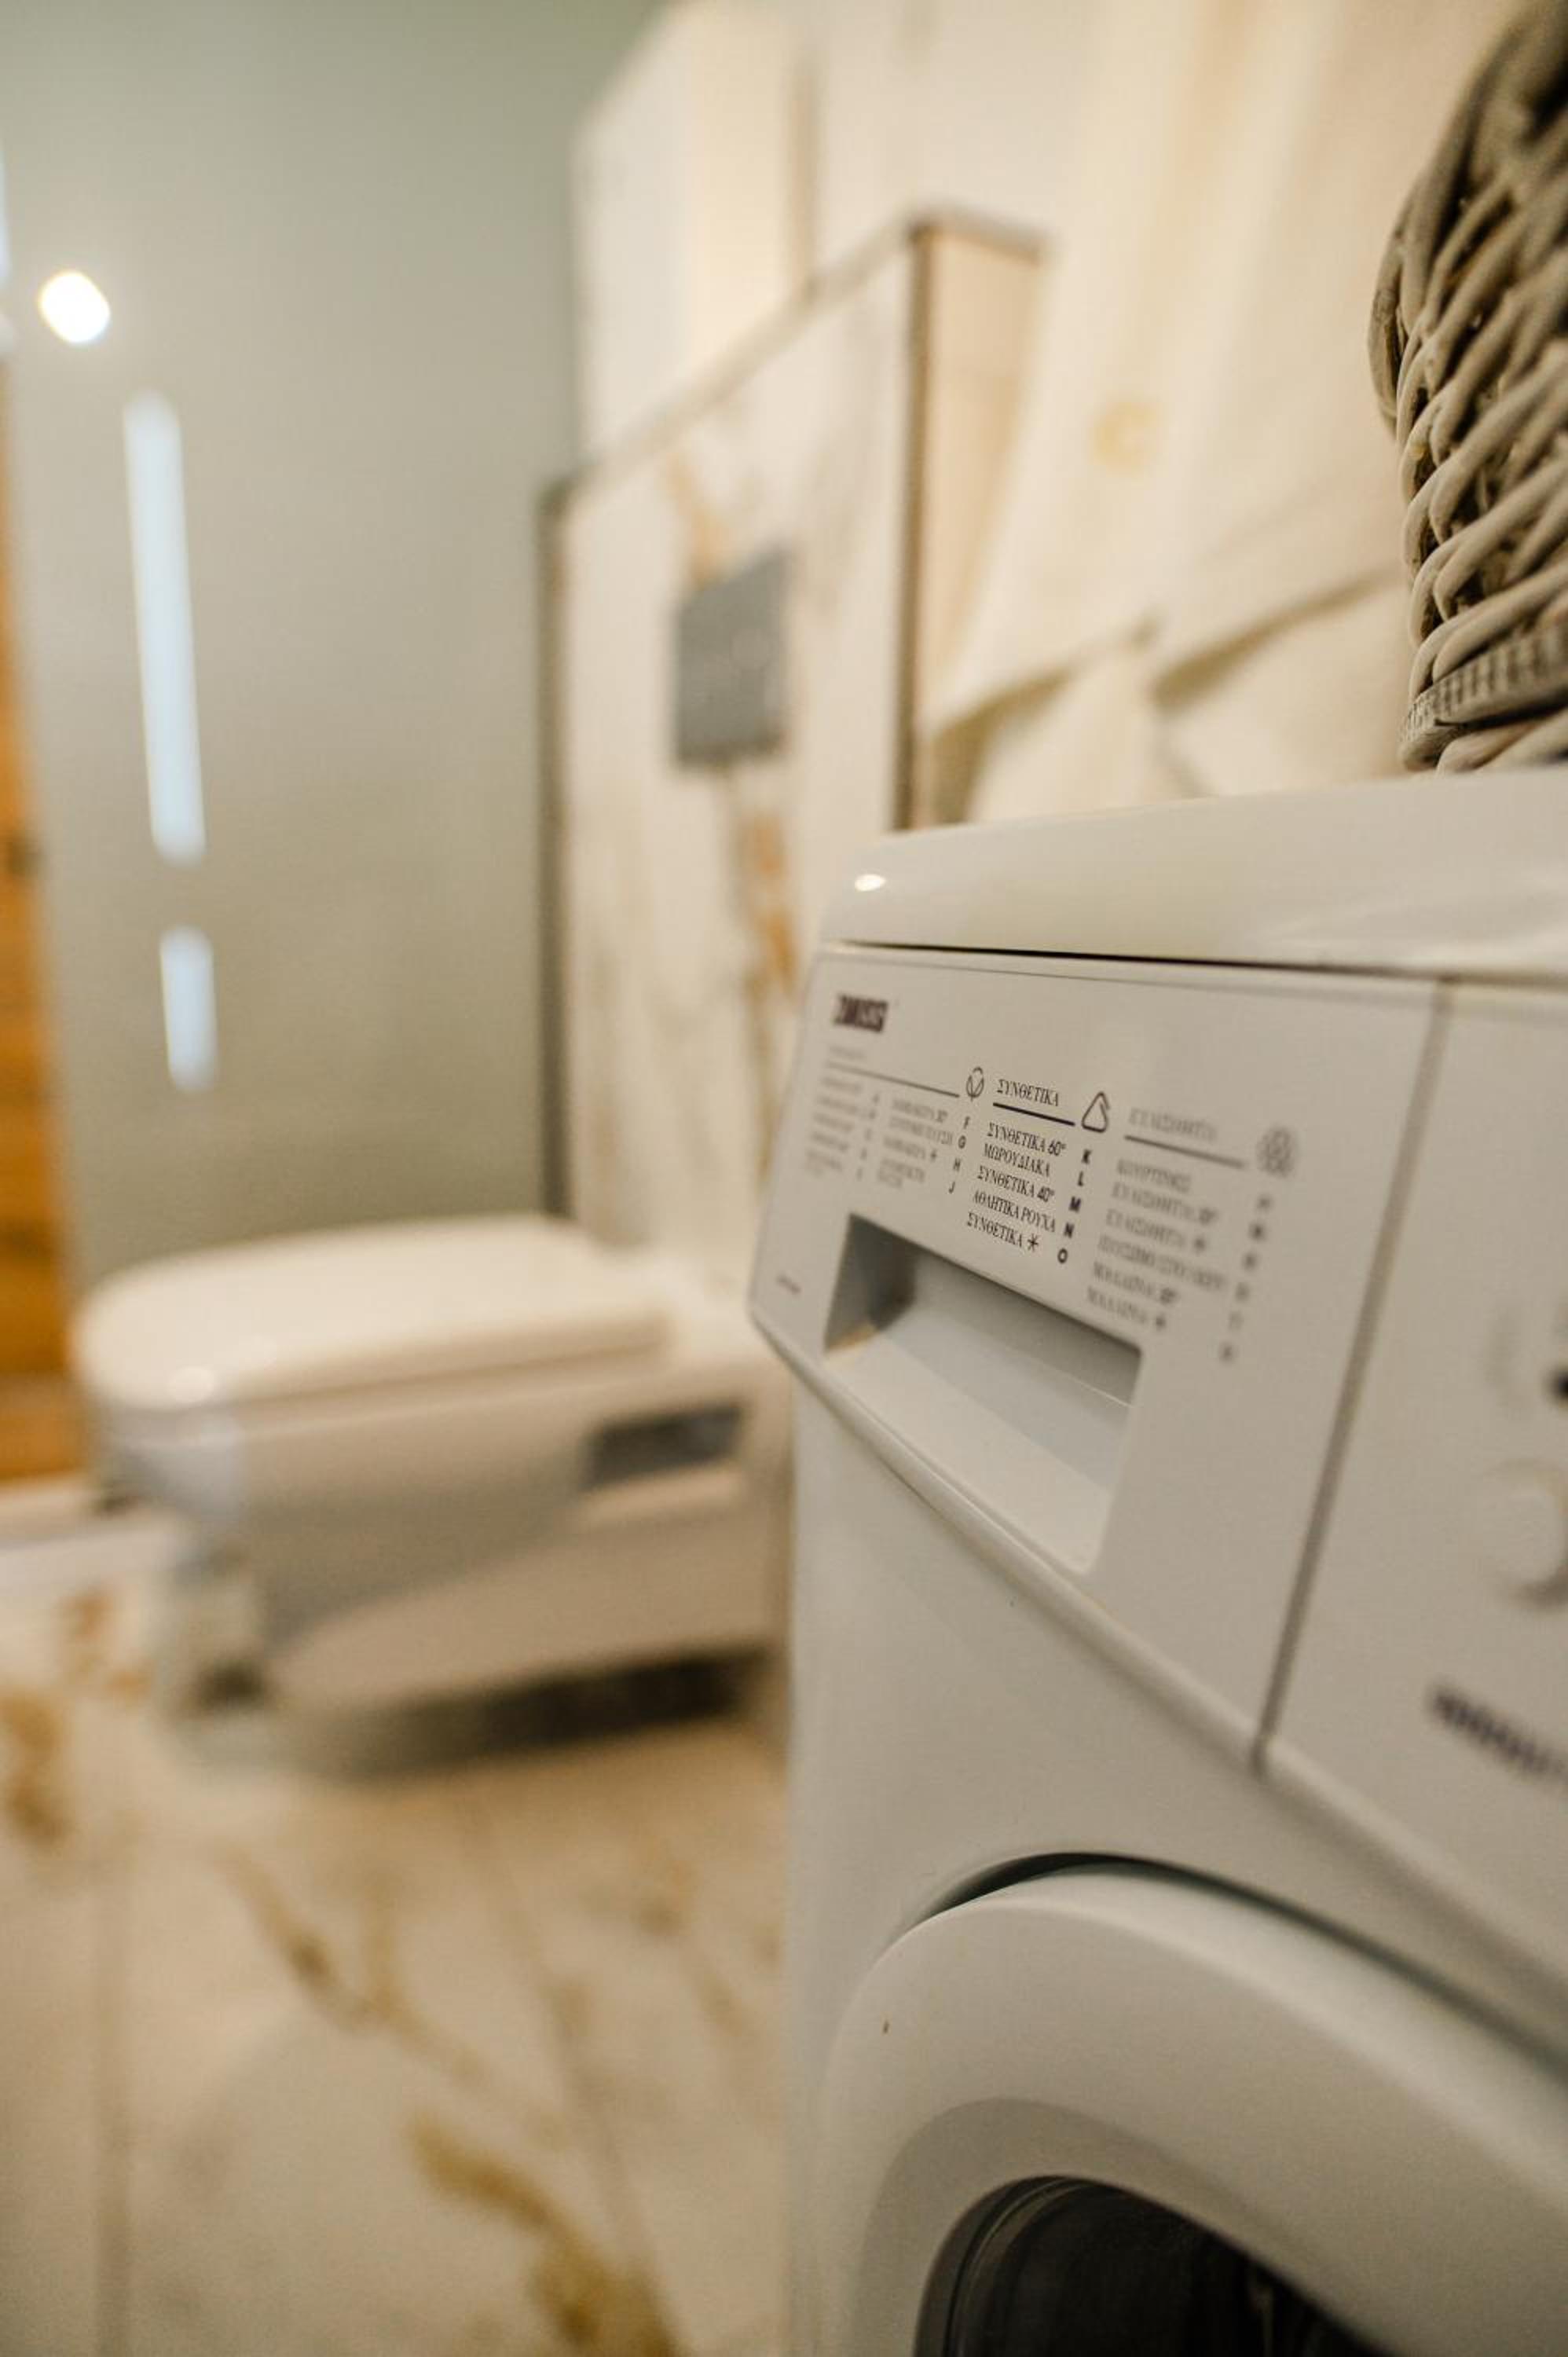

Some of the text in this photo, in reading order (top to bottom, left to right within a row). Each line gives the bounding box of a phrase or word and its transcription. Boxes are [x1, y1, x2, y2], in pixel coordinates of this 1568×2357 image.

[997, 1079, 1060, 1106] ΣΥΝΘΕΤΙΚΑ
[958, 1136, 966, 1149] G
[987, 1122, 1046, 1149] ΣΥΝΘΕΤΙΚΑ
[1082, 1149, 1092, 1164] K
[977, 1166, 1035, 1199] ΣΥΝΘΕΤΙΚΑ
[1078, 1172, 1083, 1186] L
[949, 1182, 955, 1193] J
[1069, 1197, 1081, 1212] M
[967, 1212, 1022, 1247] ΣΥΝΘΕΤΙΚΑ
[1064, 1223, 1074, 1238] N
